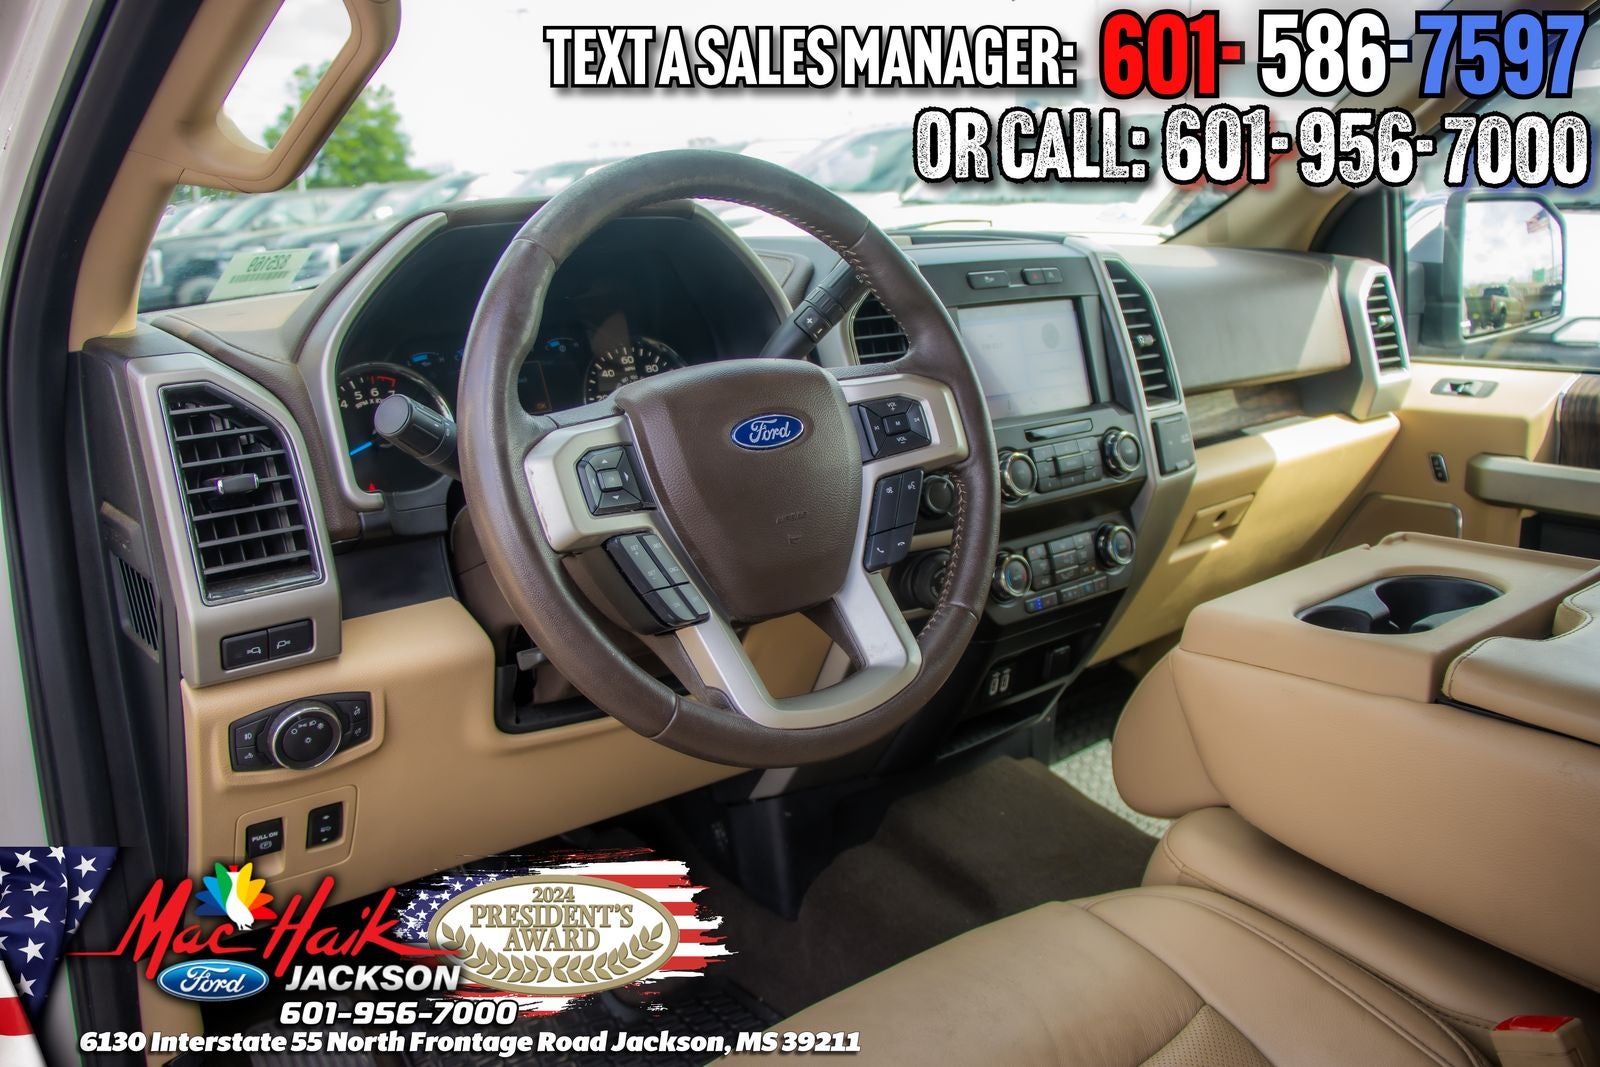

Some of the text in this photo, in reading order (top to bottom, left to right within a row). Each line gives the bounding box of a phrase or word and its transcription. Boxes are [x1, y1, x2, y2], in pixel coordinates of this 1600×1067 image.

[621, 355, 634, 365] 60
[645, 364, 659, 373] 80
[601, 369, 615, 378] 40
[354, 391, 363, 400] 5
[370, 388, 379, 397] 6
[340, 399, 349, 409] 4
[748, 418, 792, 444] Ford
[251, 834, 268, 842] PULL
